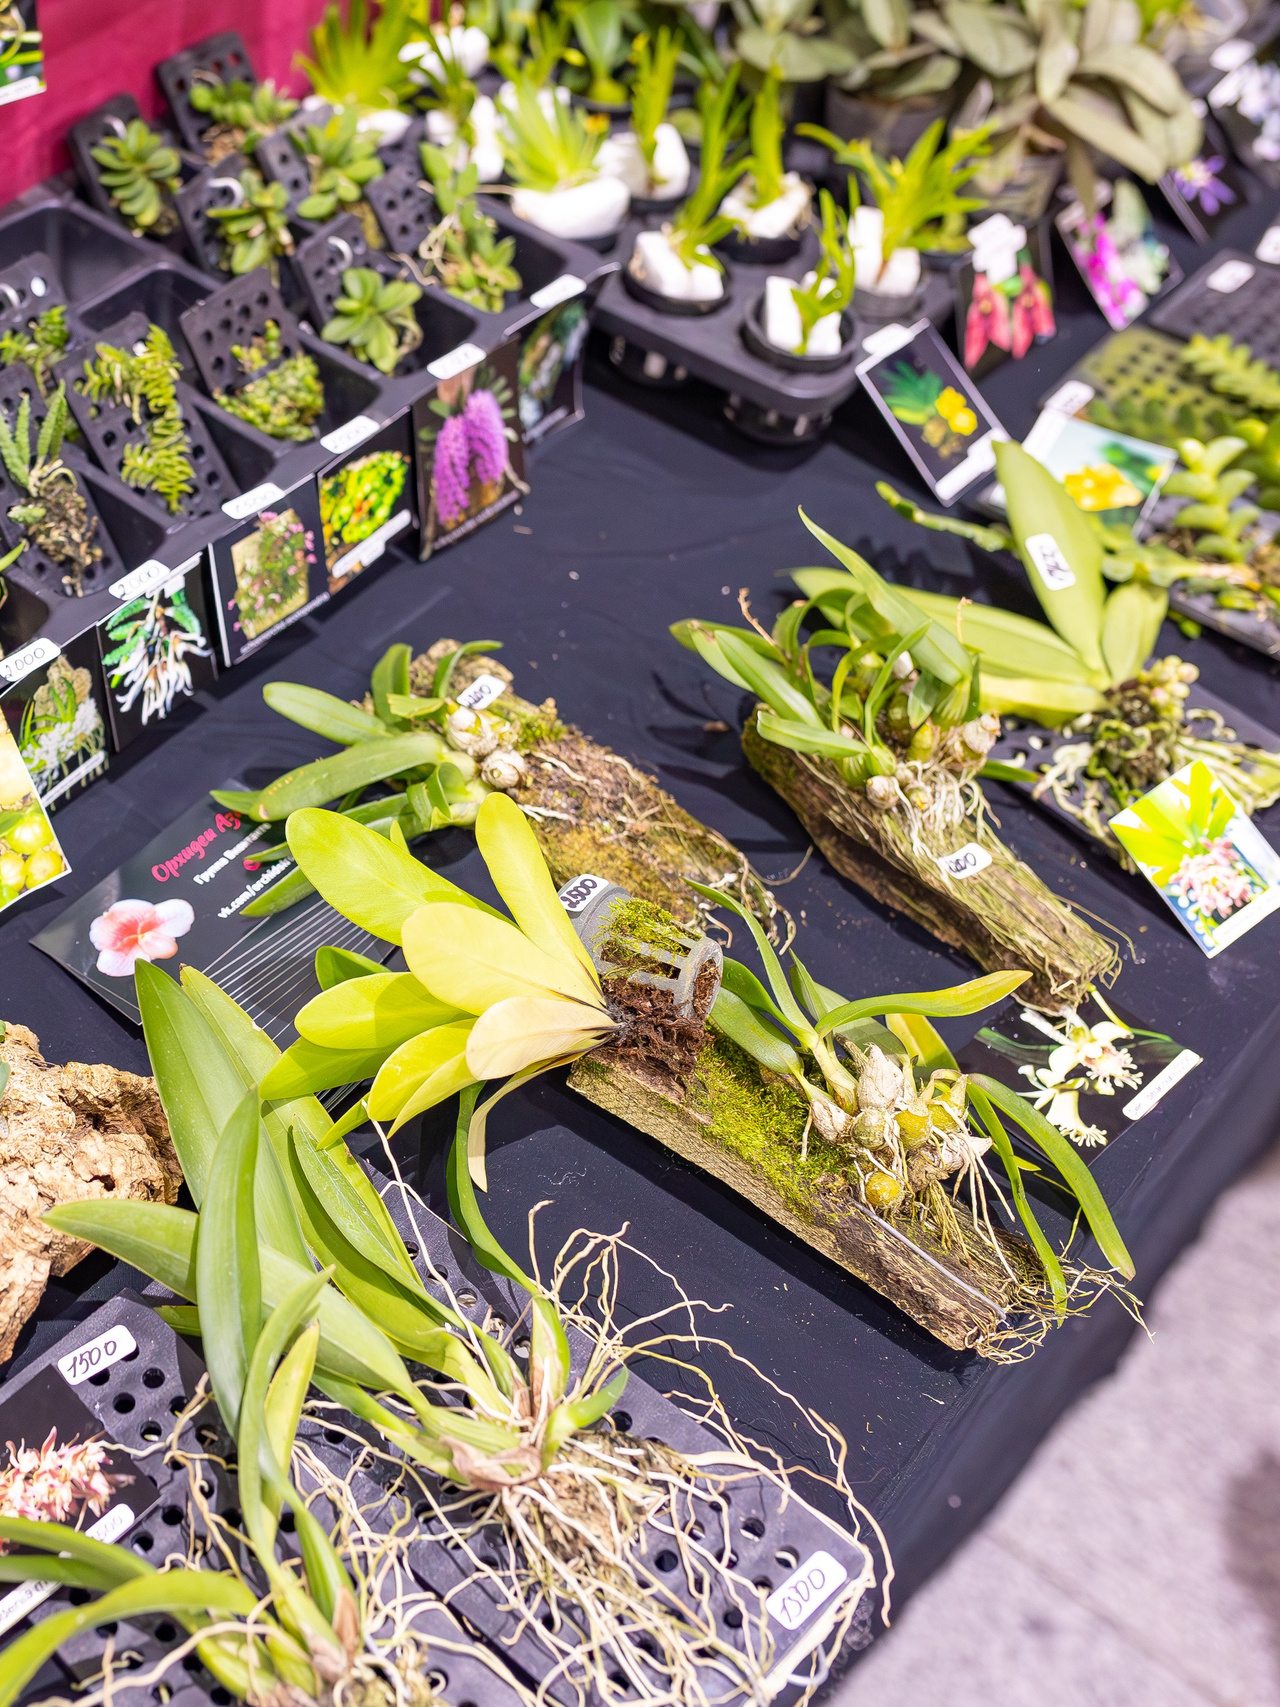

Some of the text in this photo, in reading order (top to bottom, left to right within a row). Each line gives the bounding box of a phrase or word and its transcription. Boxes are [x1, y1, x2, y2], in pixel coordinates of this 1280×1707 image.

[5, 647, 45, 681] 2000
[151, 828, 218, 882] Орхидеи
[66, 1340, 117, 1378] 1500
[92, 1515, 123, 1542] 500
